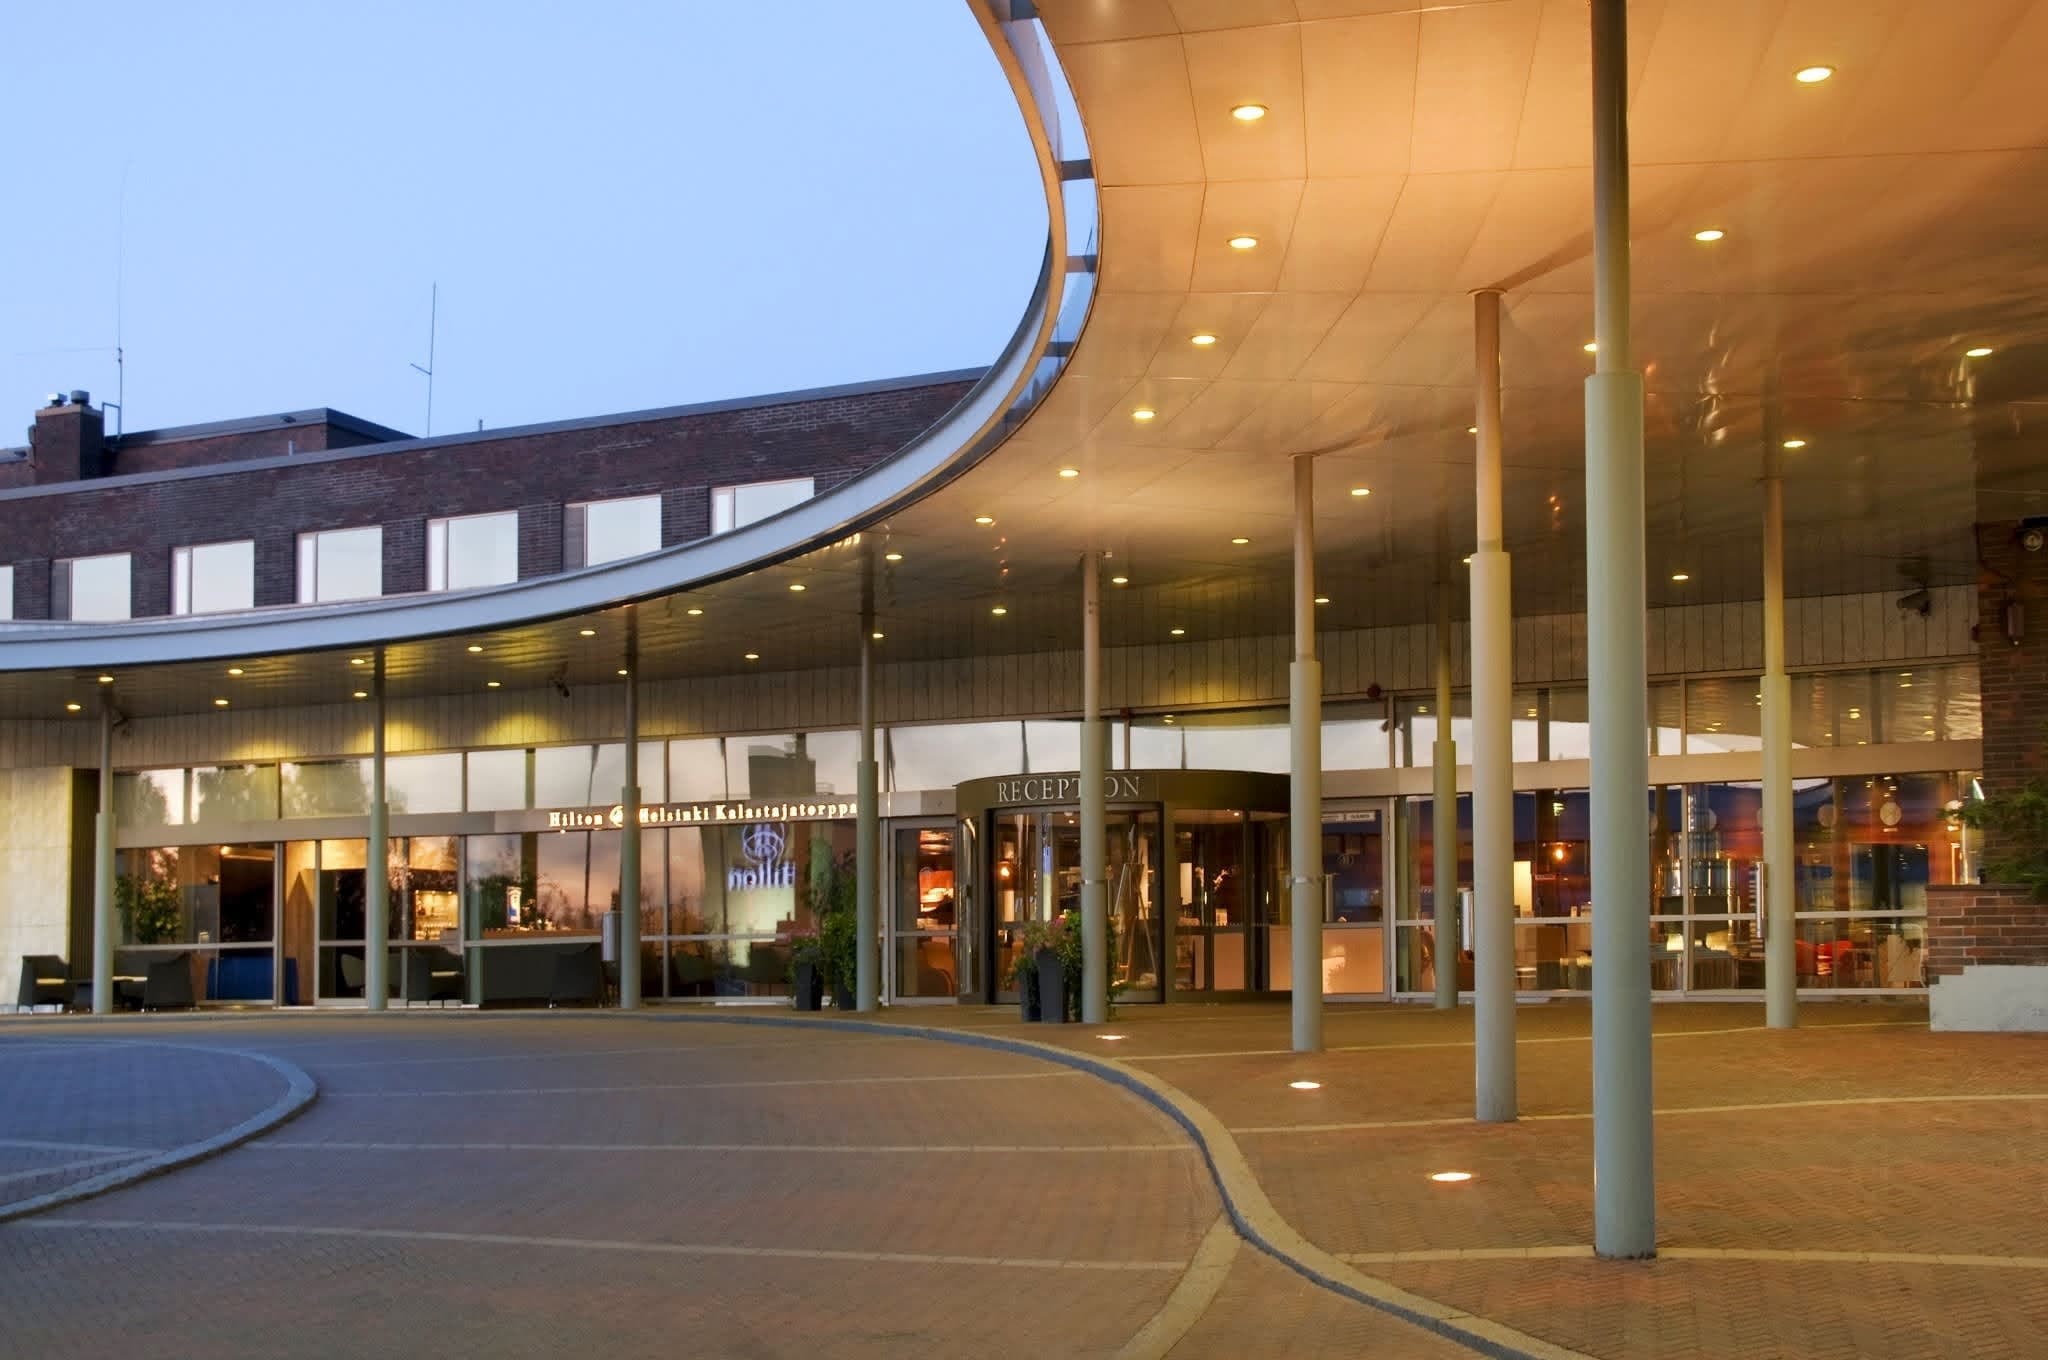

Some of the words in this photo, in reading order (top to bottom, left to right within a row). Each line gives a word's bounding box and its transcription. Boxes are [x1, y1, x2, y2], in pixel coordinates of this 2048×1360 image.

[997, 776, 1140, 803] RECEPTON
[549, 811, 603, 827] Hilton
[639, 806, 709, 823] Helsinki
[715, 803, 858, 821] Kalastajatorppa
